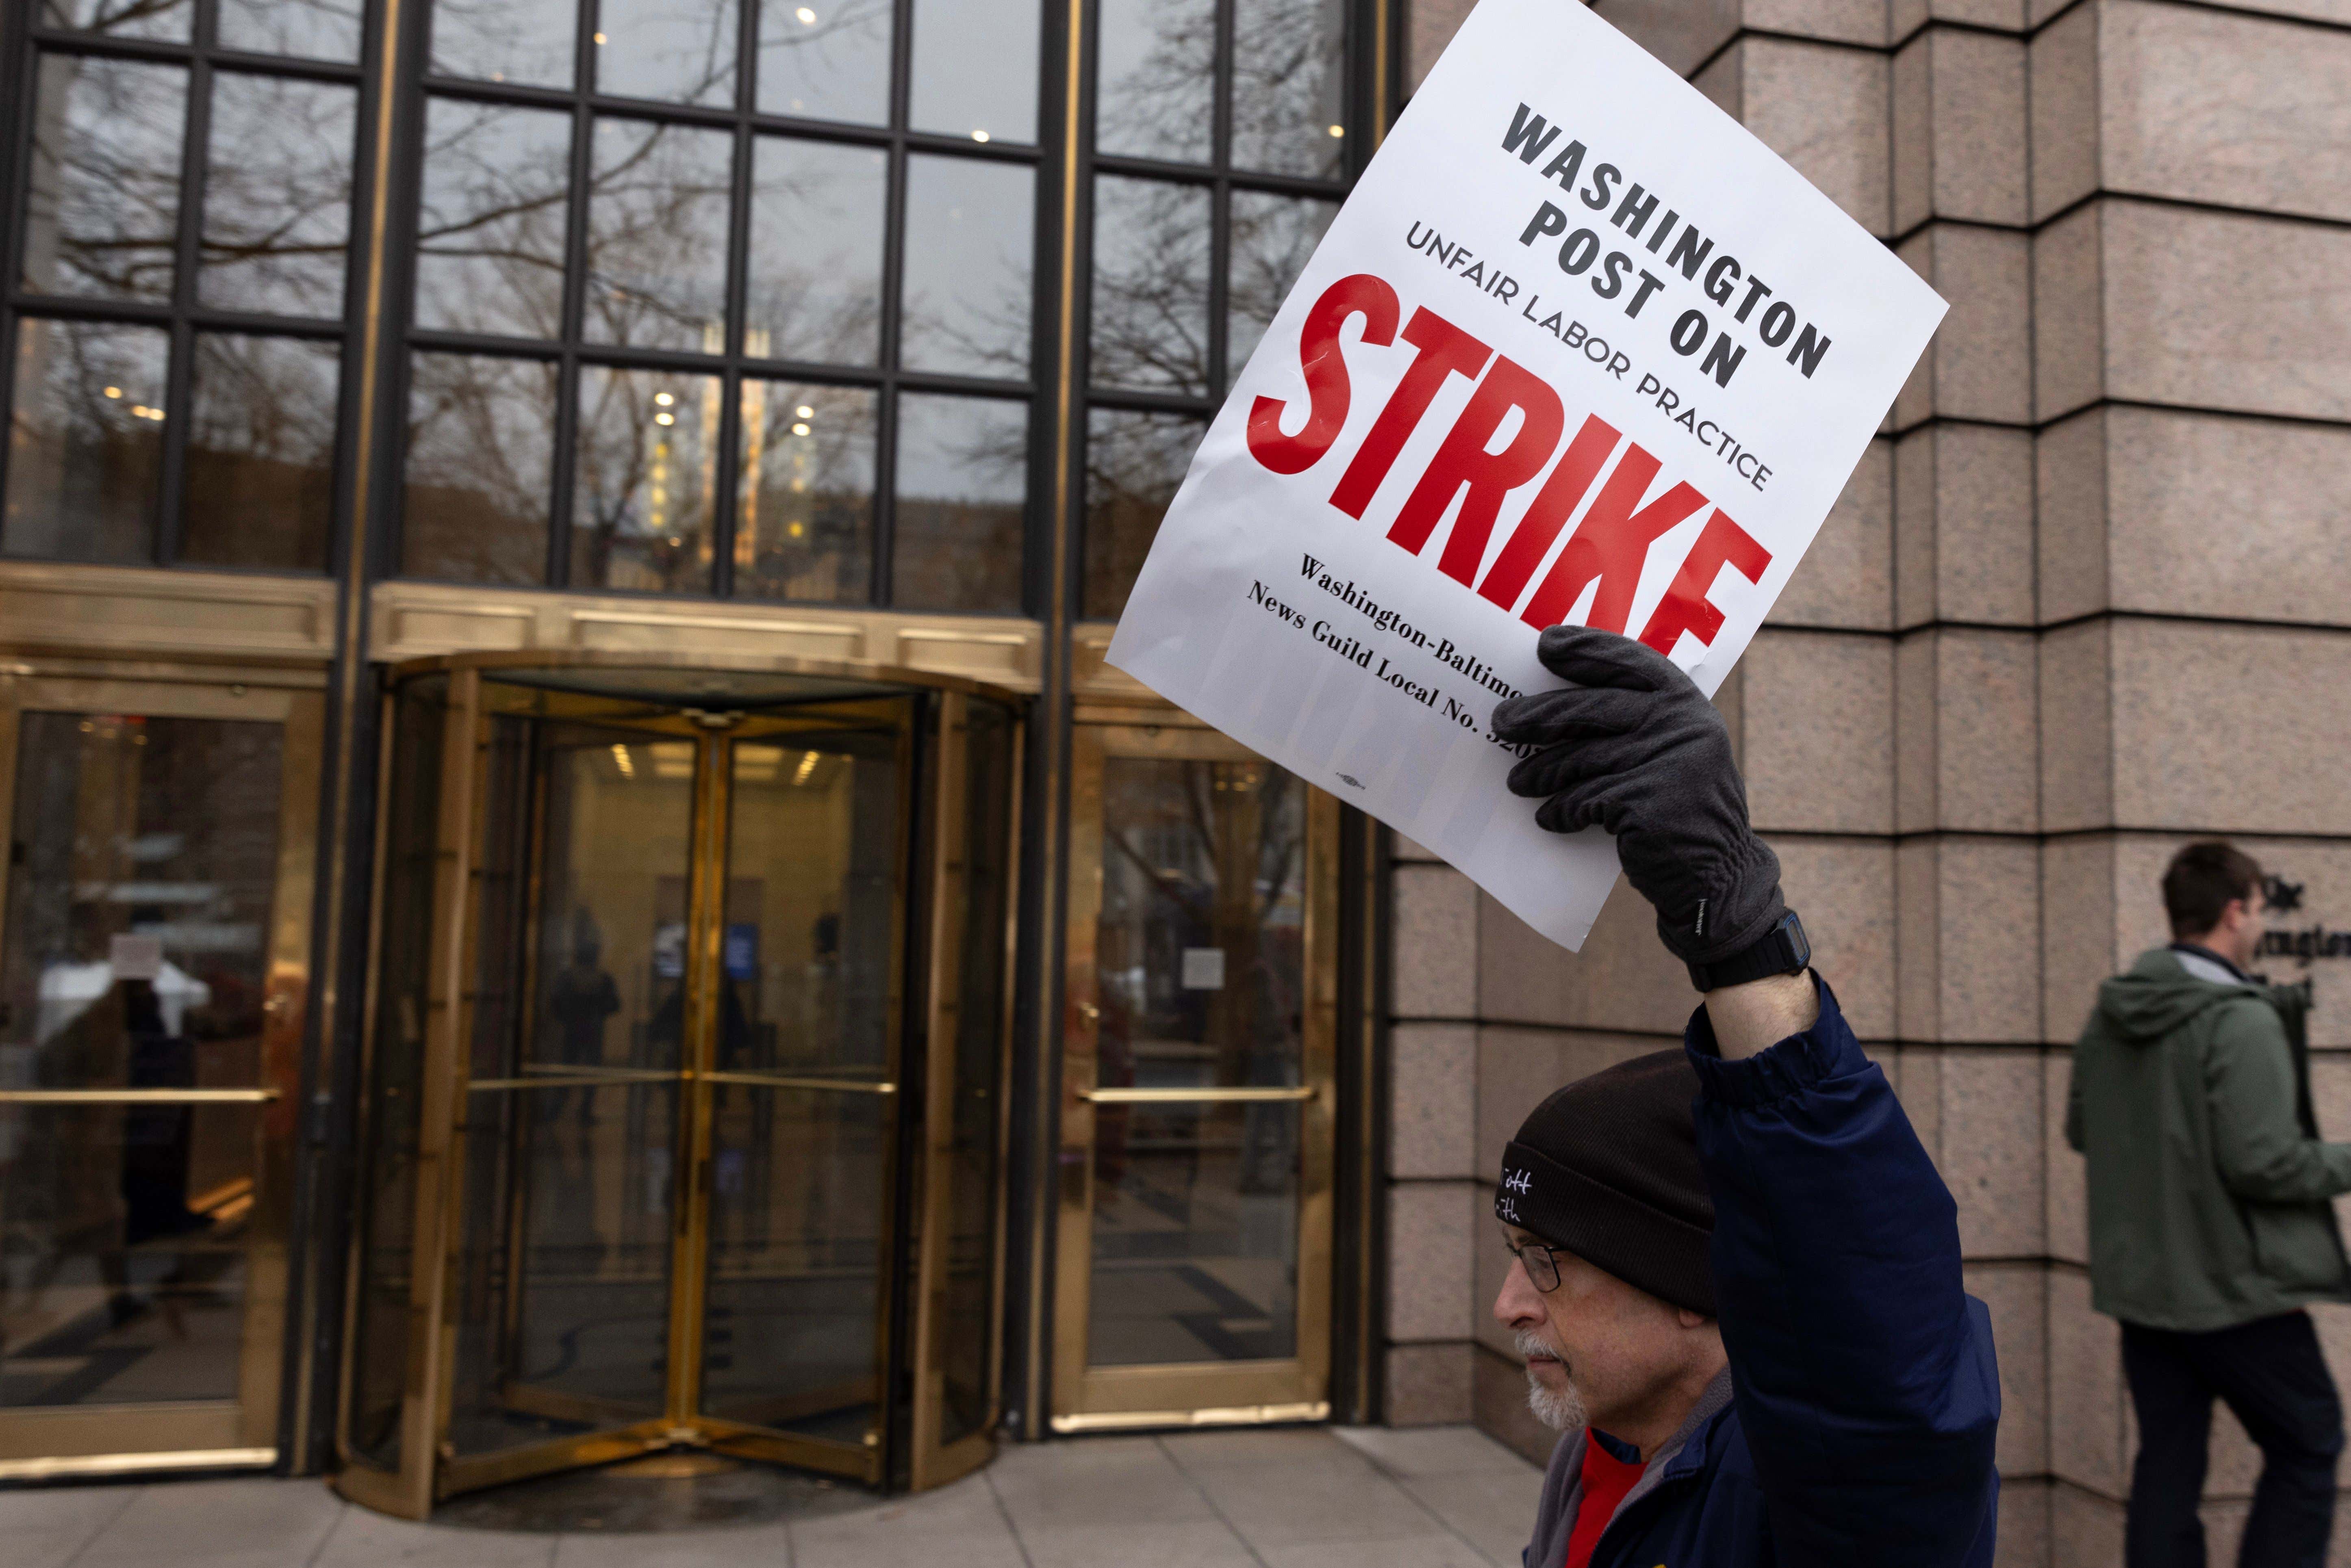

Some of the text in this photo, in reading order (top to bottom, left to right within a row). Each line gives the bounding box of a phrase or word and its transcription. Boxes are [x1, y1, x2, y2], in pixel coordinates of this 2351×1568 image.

[1407, 221, 1773, 492] UNFAIR LABOR PRACTICE
[1501, 102, 1832, 379] WASHINGTON
[1519, 200, 1748, 389] POST ON
[1247, 274, 1773, 657] STRIKE
[1246, 580, 1307, 629] News
[1311, 620, 1375, 670] Guild
[1374, 657, 1440, 709] Local
[1440, 696, 1478, 733] No.
